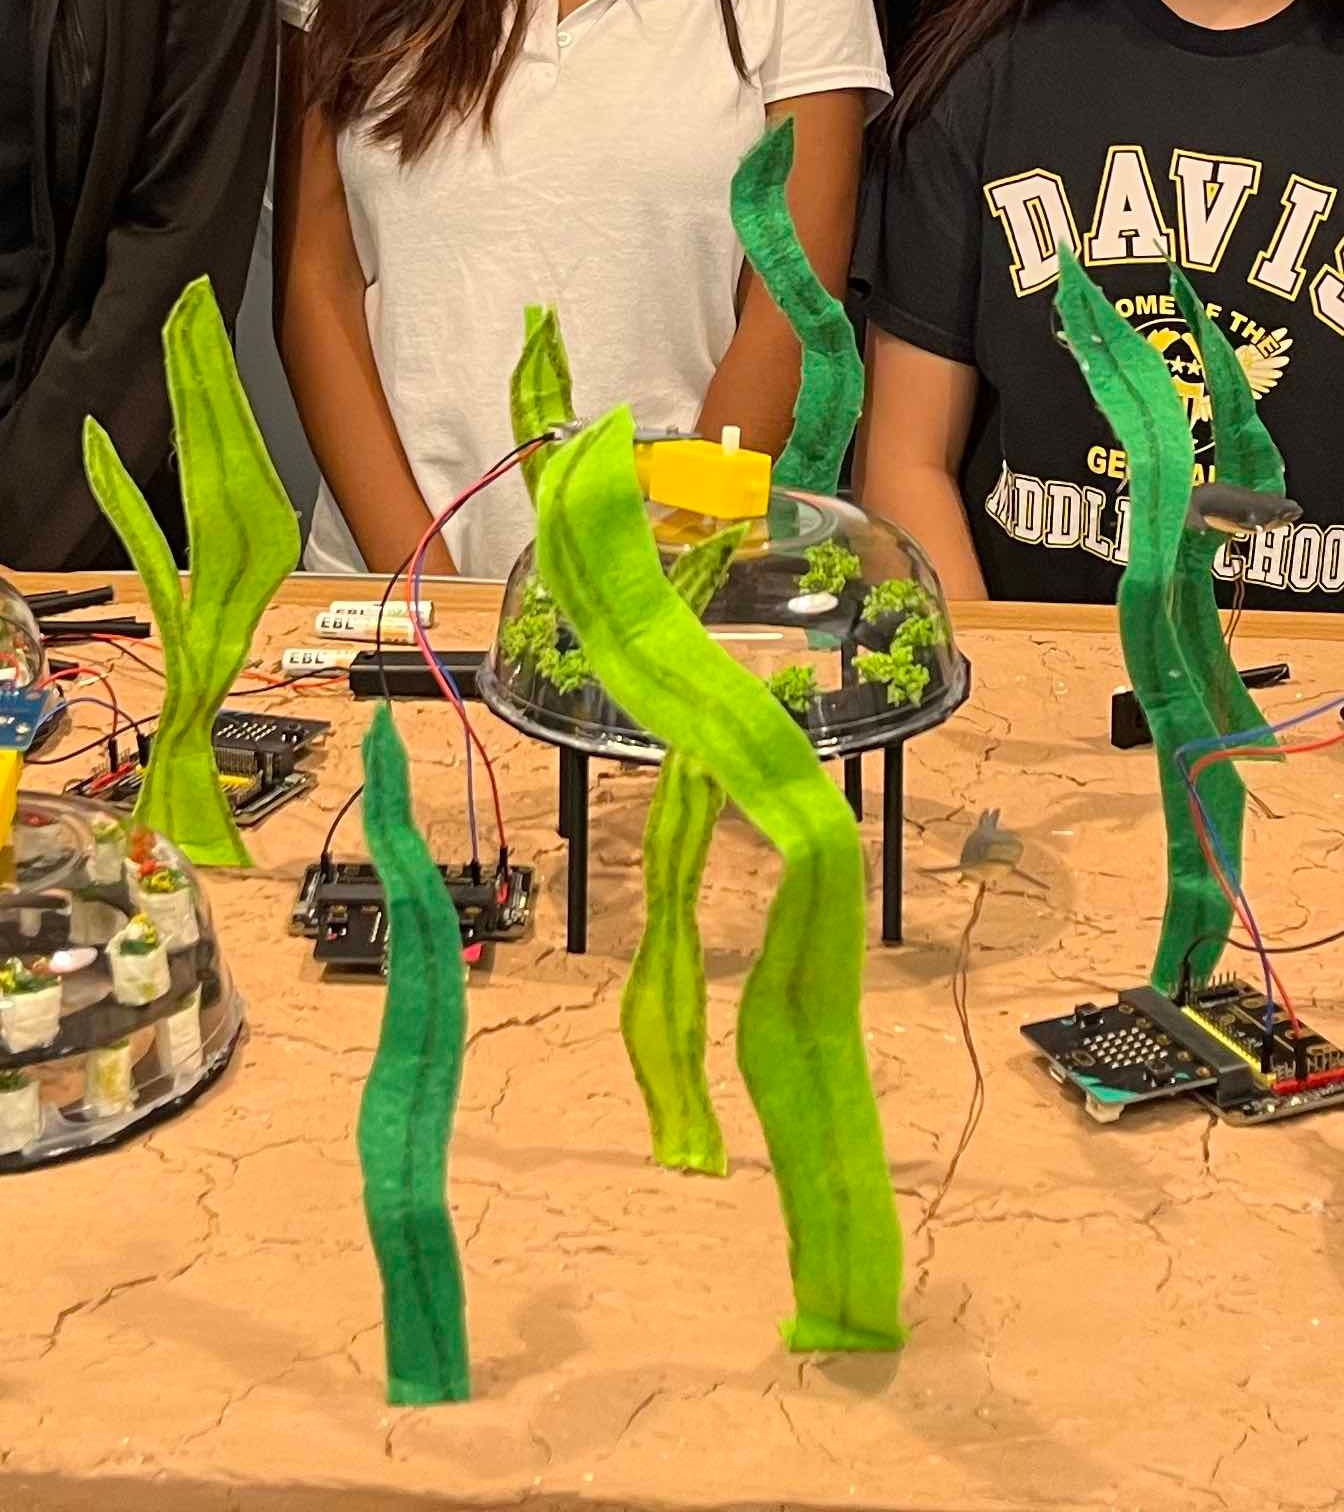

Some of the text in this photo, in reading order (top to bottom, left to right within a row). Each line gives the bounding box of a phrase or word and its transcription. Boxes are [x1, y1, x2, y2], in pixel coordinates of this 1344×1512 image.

[1114, 294, 1283, 359] OME F THE
